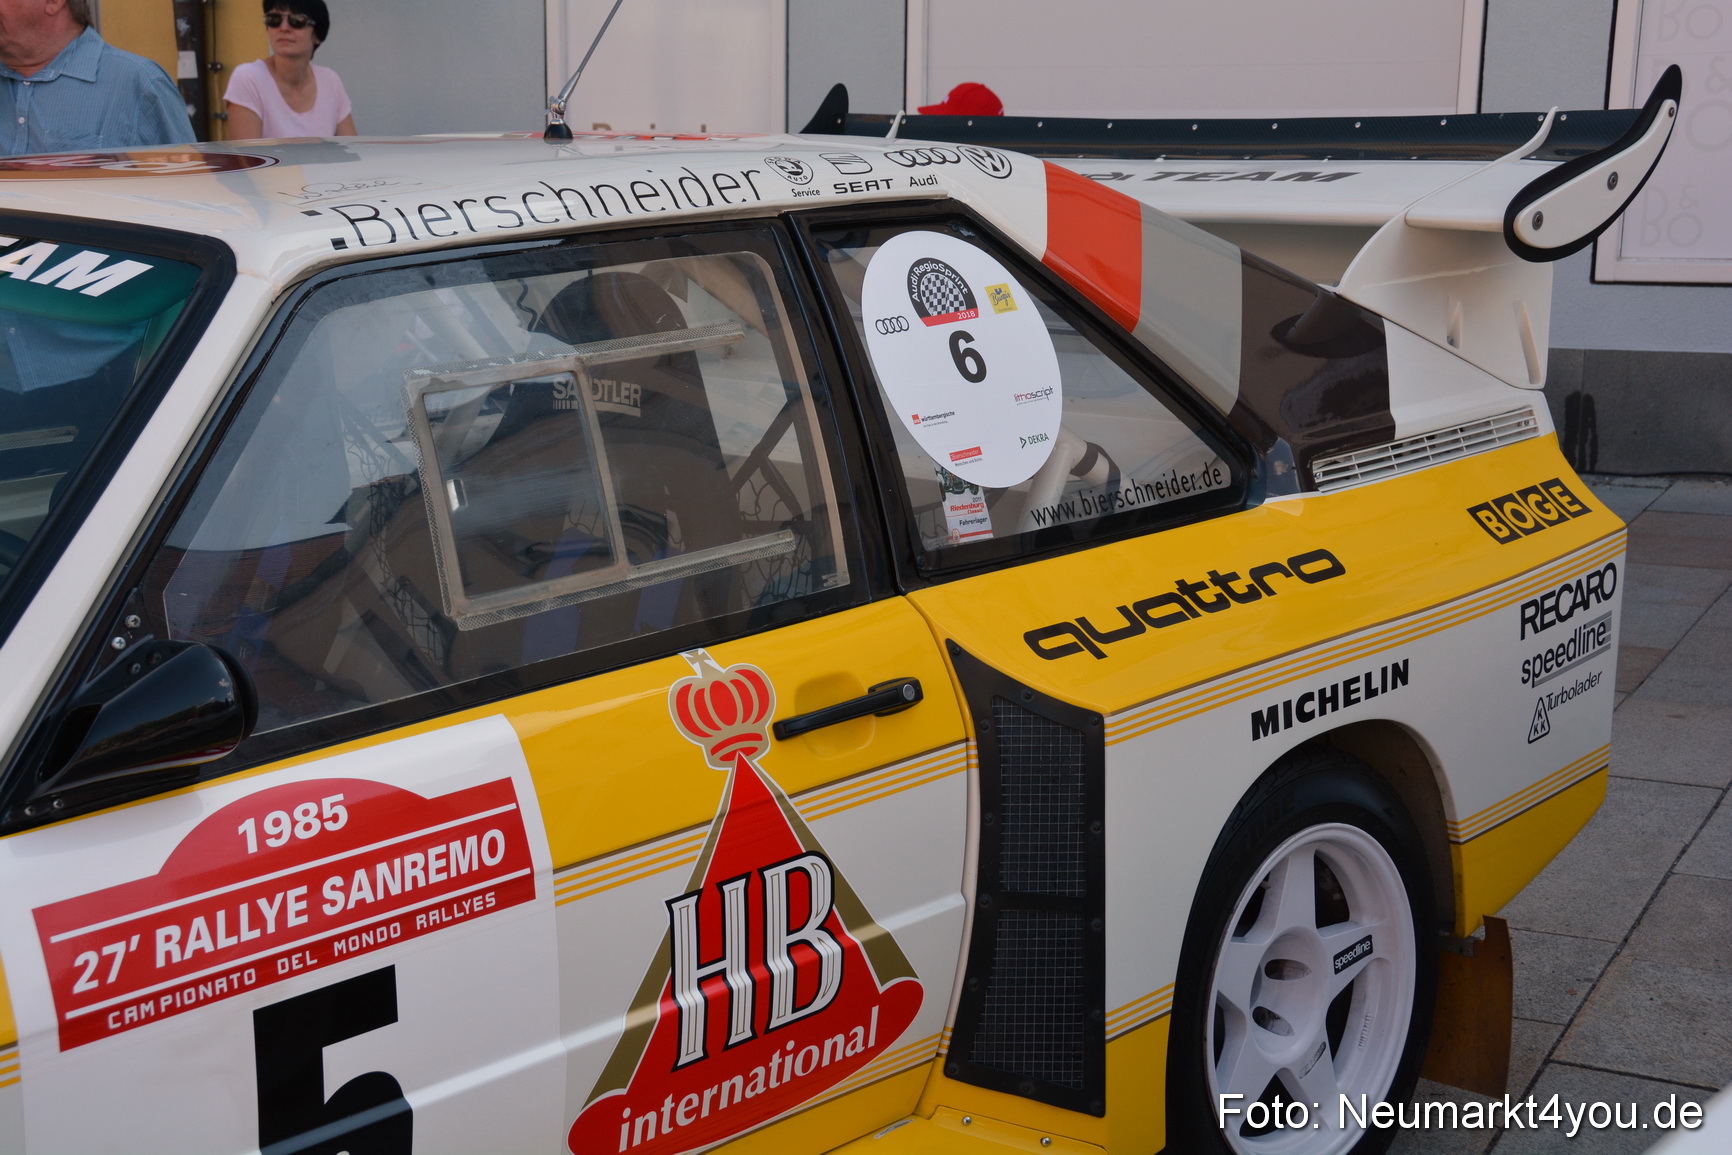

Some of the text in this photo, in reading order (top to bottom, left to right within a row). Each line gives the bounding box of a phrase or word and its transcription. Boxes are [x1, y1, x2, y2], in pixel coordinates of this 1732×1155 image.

[791, 187, 820, 198] Service
[833, 179, 893, 194] SEAT
[909, 174, 938, 188] Audi
[1142, 171, 1361, 183] TEAM
[329, 167, 762, 248] Bierschneider
[957, 311, 976, 320] 2018
[949, 330, 987, 383] 6
[553, 376, 641, 408] SADTLER
[1028, 432, 1049, 444] DEKRA
[950, 502, 985, 512] Riedenburg
[1031, 462, 1222, 527] www.bierschneider.de
[1475, 485, 1583, 539] BOGE
[959, 517, 988, 526] Fahrerlager
[1023, 549, 1346, 660] quattro
[1520, 562, 1617, 641] RECARO
[1521, 621, 1607, 689] speedline
[1251, 658, 1409, 741] MICHELIN
[1546, 671, 1603, 712] Turbolader
[237, 793, 349, 854] 1985
[155, 885, 308, 968] RALLYE
[321, 828, 506, 917] SANREMO
[107, 891, 497, 1031] CAMPIONATO DEL MONDO RALLYES
[667, 852, 843, 1072] HB
[1334, 940, 1371, 970] speedline
[619, 1005, 880, 1154] international
